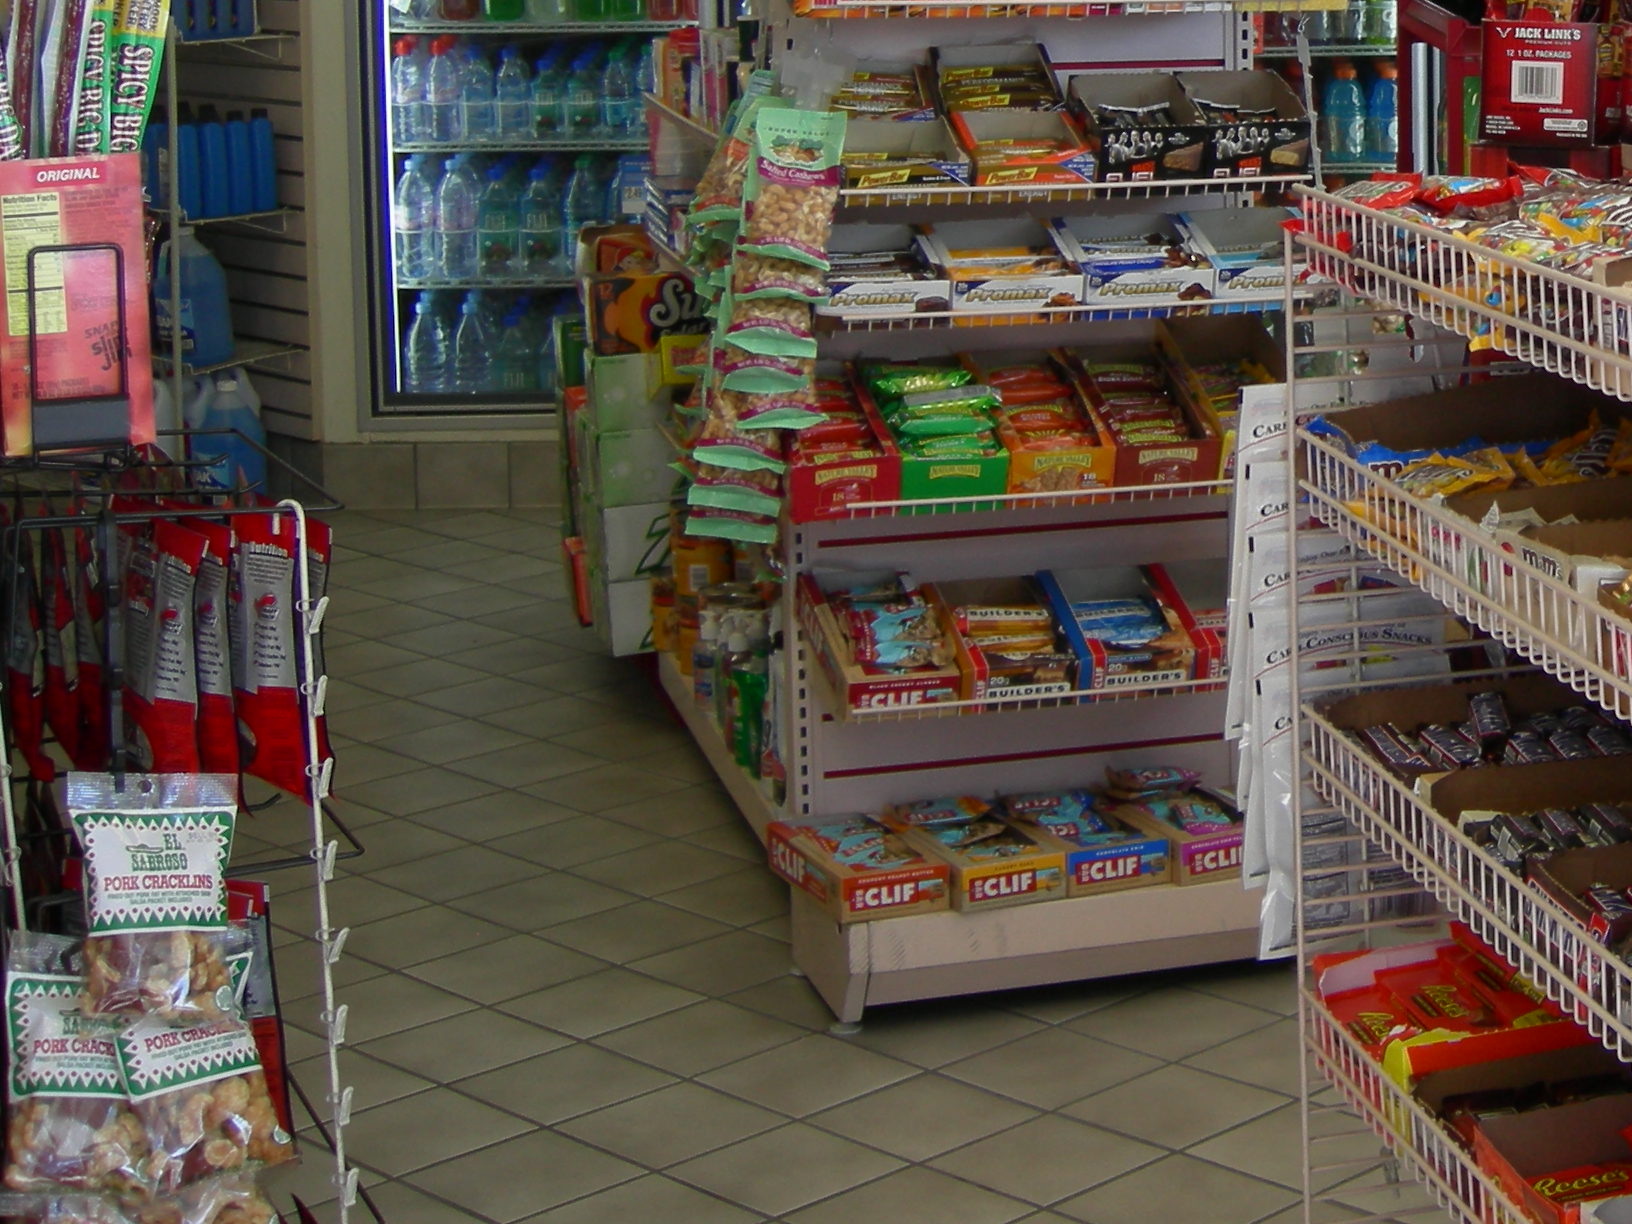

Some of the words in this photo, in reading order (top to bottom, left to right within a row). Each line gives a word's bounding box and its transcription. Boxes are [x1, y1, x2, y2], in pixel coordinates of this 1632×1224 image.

[1515, 28, 1542, 39] JACK
[1544, 28, 1581, 40] LINK'S
[37, 167, 100, 183] ORIGINAL
[966, 285, 1052, 303] Promax
[1100, 278, 1183, 295] Promax
[831, 289, 917, 307] Promax
[1107, 672, 1182, 686] BUILDER'S
[988, 685, 1067, 698] BUILDER'S
[163, 833, 183, 850] EL
[132, 853, 189, 872] SABROSO
[1090, 856, 1139, 881] CLIF
[104, 876, 140, 892] PORK
[141, 874, 213, 890] CRACKLINS
[984, 871, 1034, 896] CLIF
[864, 883, 916, 907] CLIF
[34, 1039, 68, 1055] PORK
